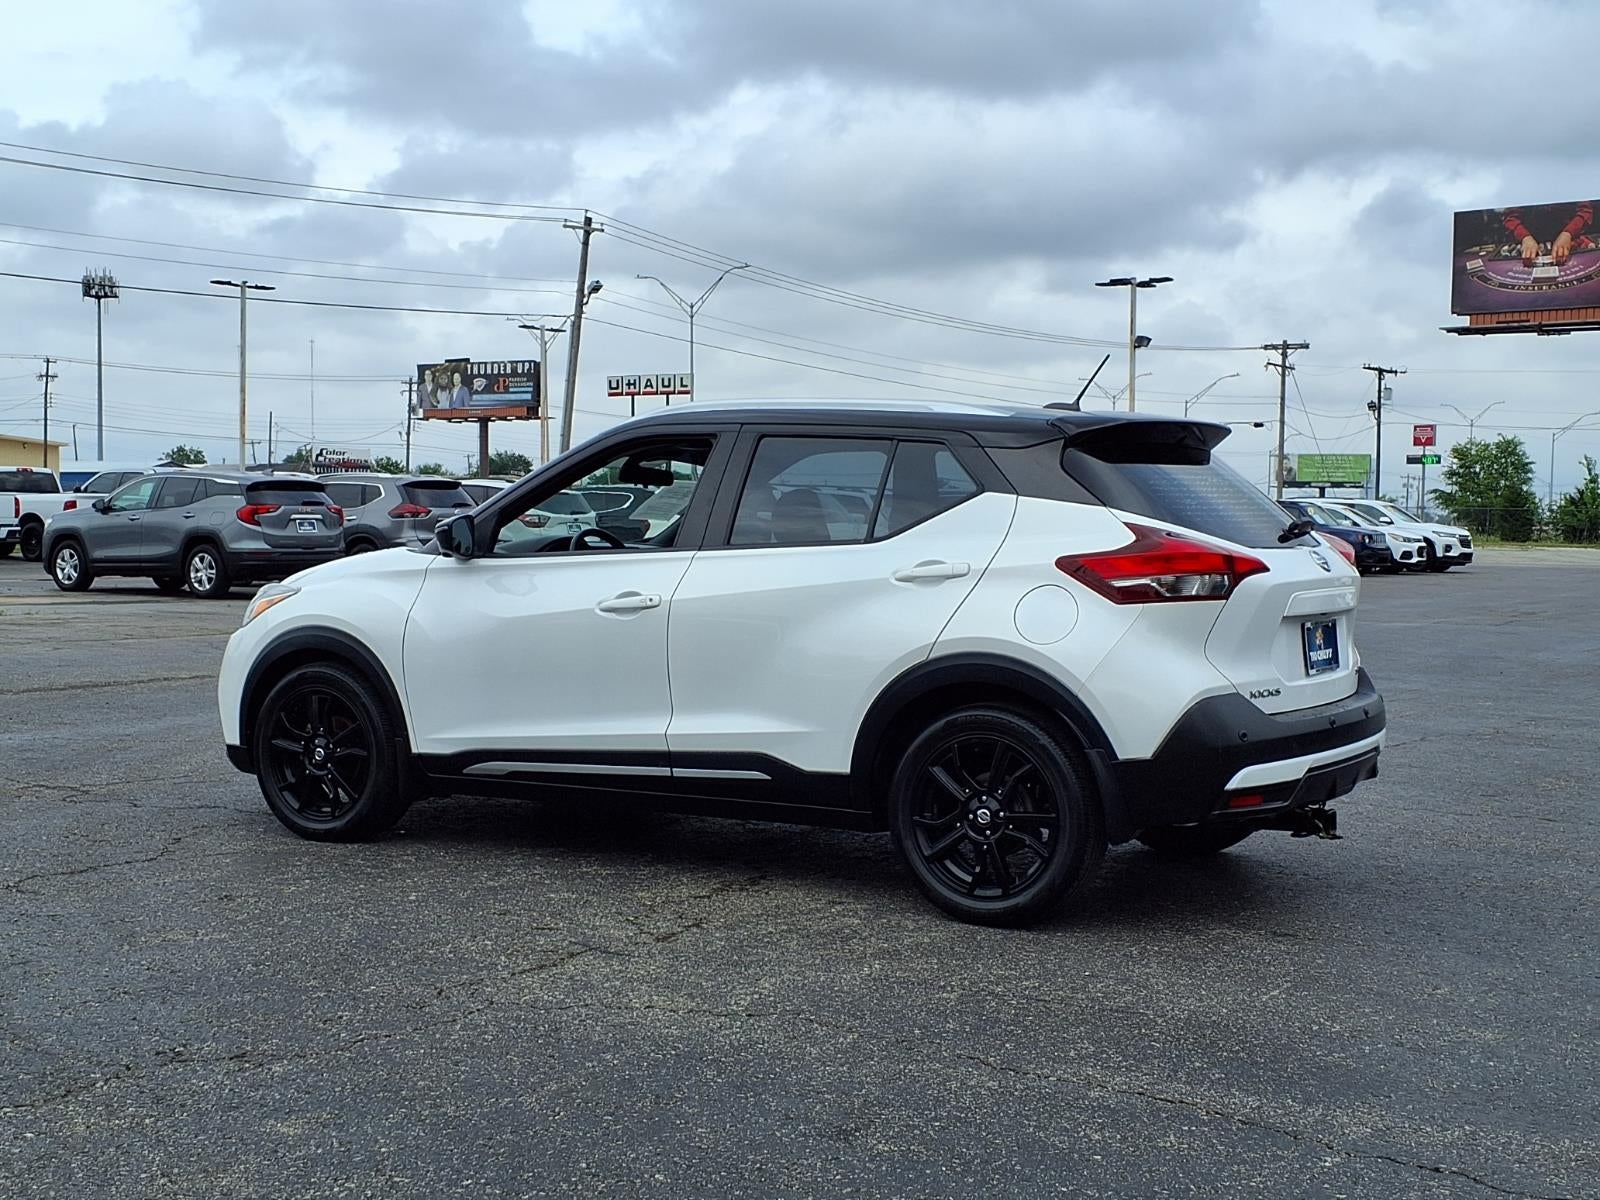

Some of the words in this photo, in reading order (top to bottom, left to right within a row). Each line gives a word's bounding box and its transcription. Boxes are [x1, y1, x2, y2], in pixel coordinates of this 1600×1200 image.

[467, 362, 512, 375] THUNDER
[517, 361, 535, 374] UP!
[319, 447, 348, 457] Color
[315, 455, 369, 465] Creations
[1249, 688, 1281, 699] KICKS
